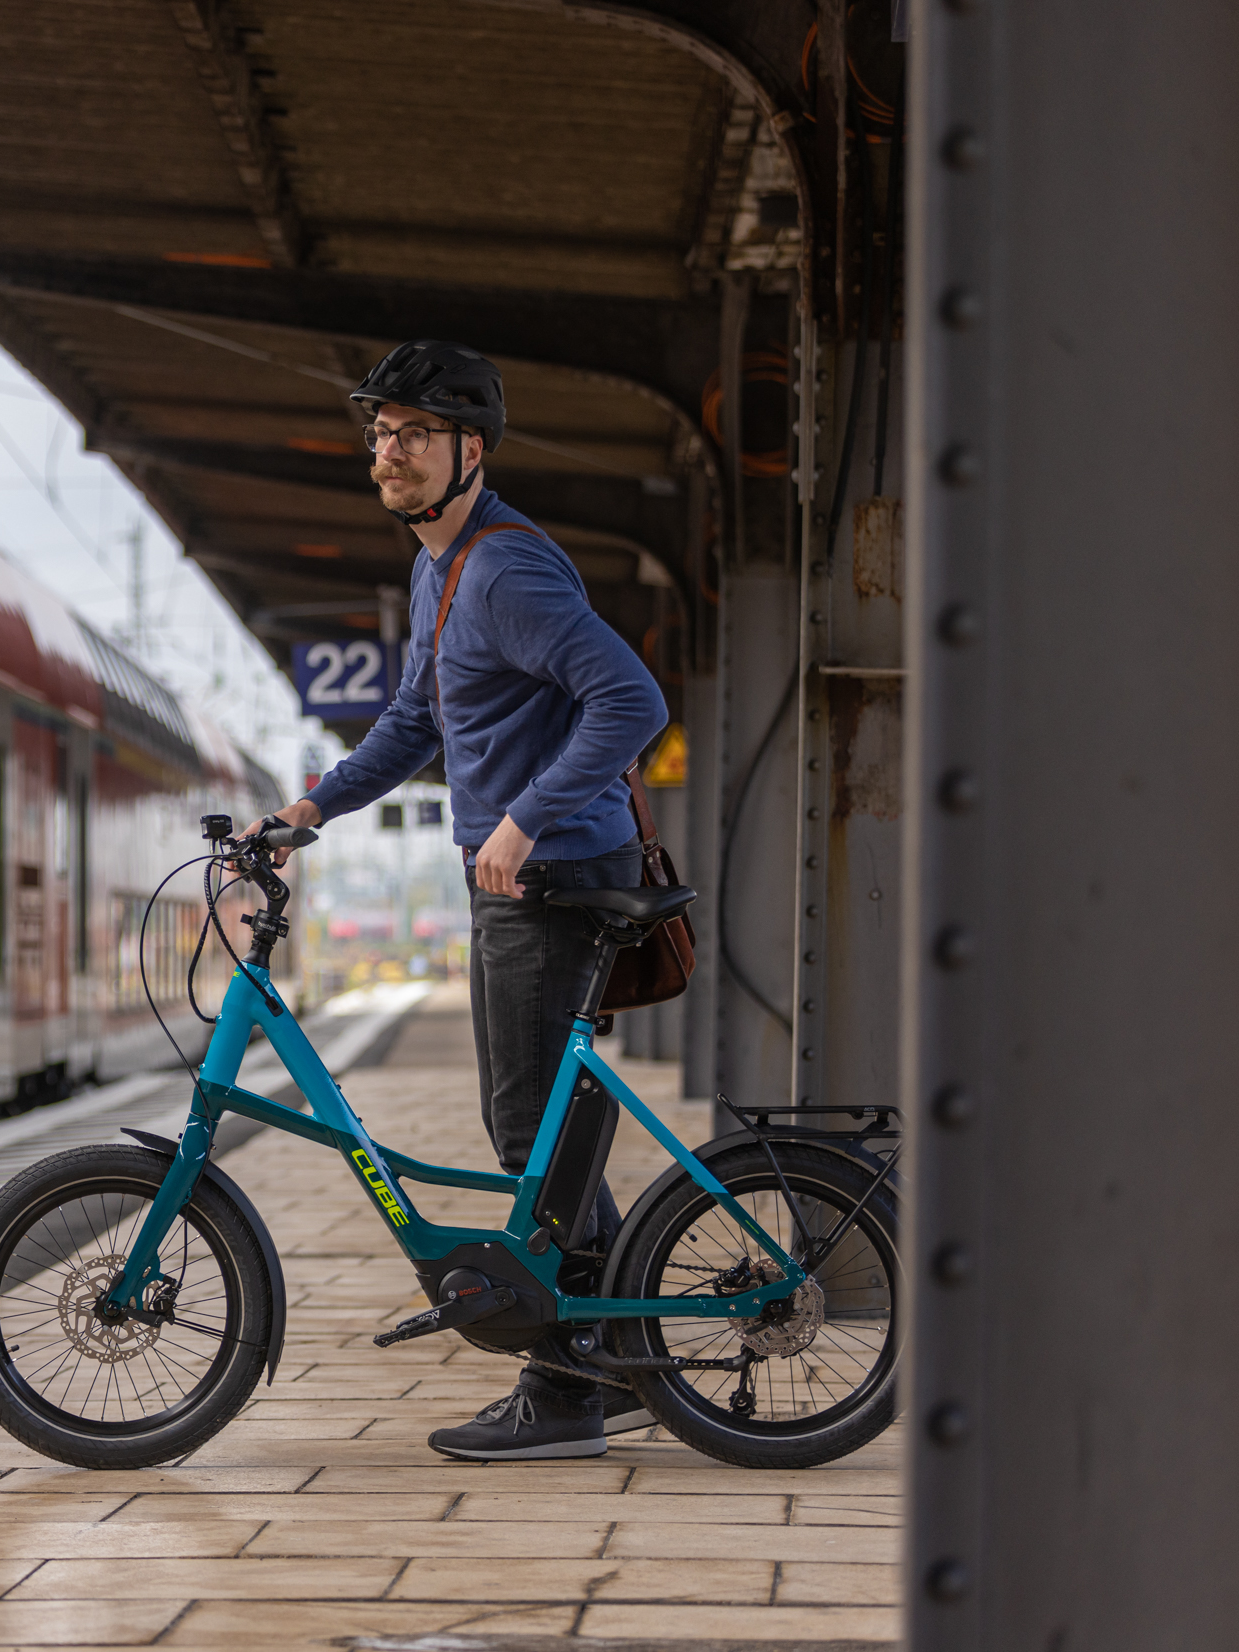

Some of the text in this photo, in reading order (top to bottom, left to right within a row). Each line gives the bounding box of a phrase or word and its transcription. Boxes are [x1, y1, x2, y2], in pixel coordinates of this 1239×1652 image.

[305, 640, 384, 705] 22
[352, 1149, 410, 1227] CUBE
[458, 1286, 482, 1297] BOSCH
